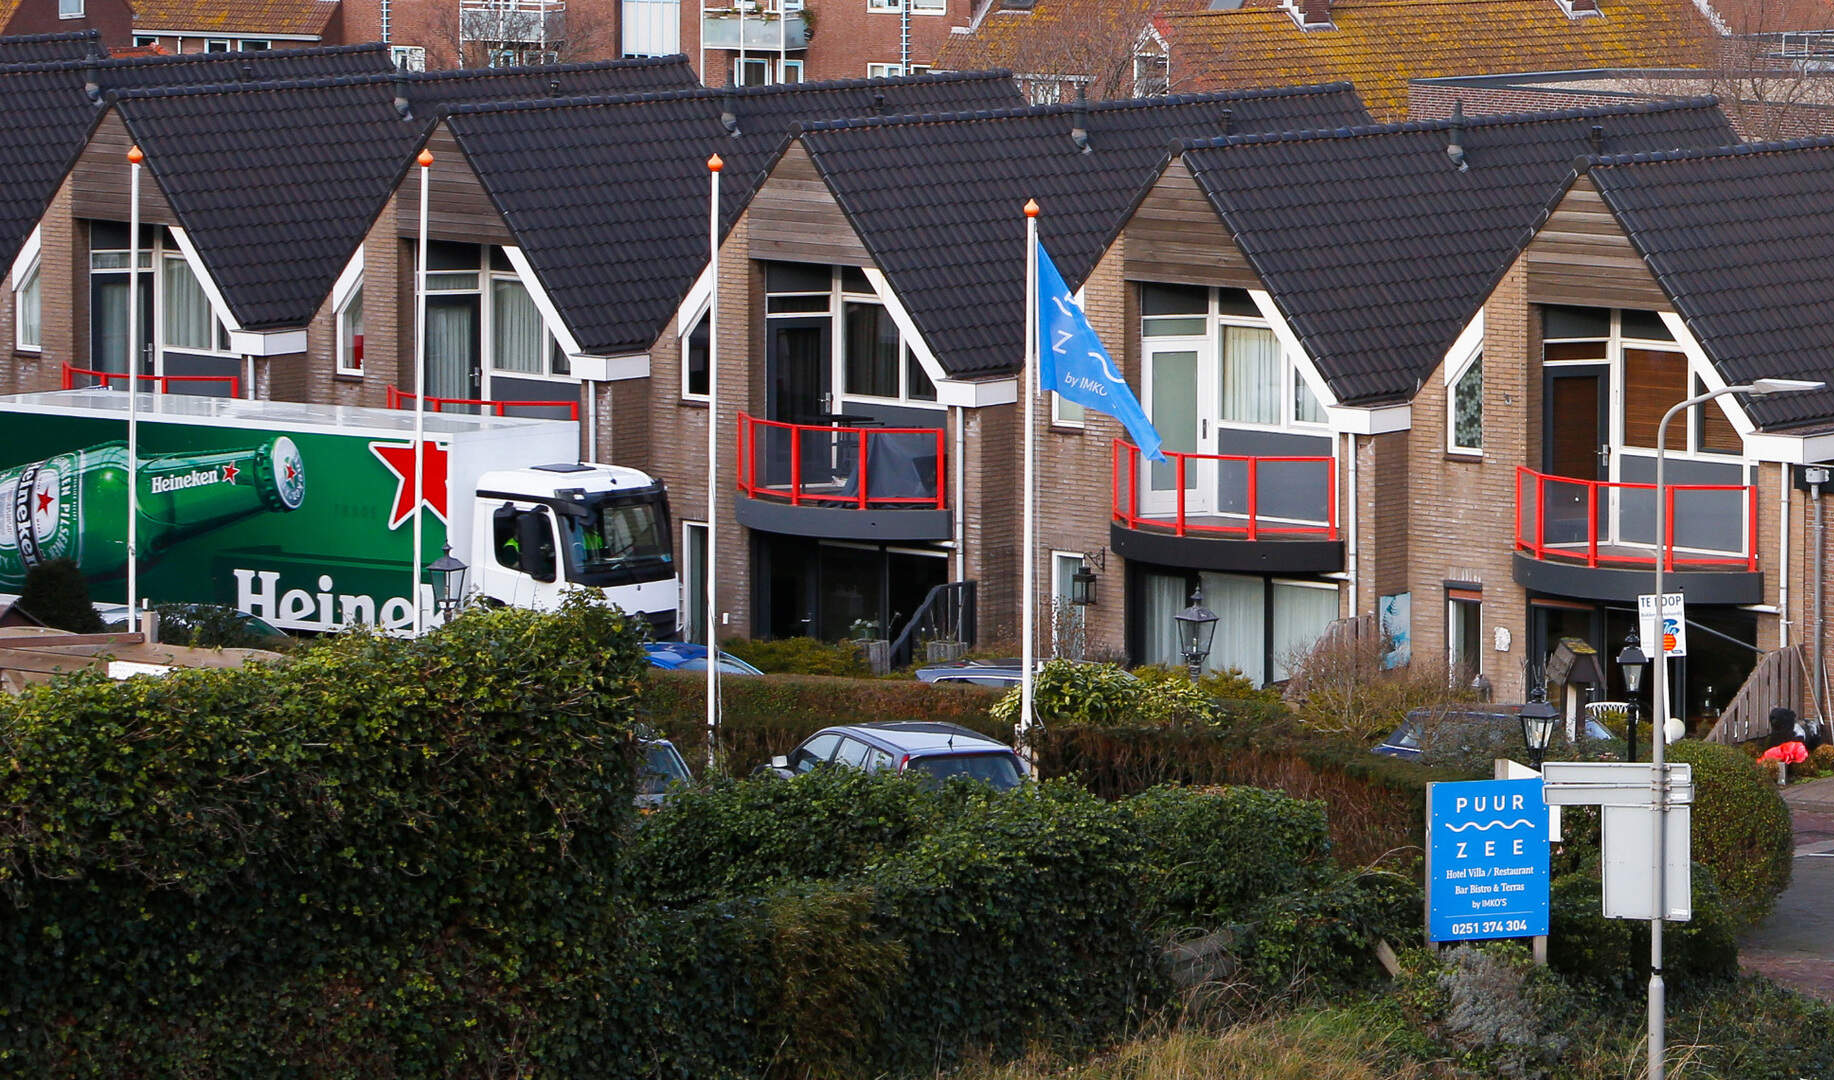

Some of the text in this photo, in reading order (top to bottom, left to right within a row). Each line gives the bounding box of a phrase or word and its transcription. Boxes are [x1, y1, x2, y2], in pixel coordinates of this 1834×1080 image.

[1065, 372, 1079, 388] by
[151, 470, 218, 494] Heineken
[1640, 595, 1682, 608] TE OOP
[1456, 794, 1525, 813] PUUR
[1456, 839, 1525, 859] ZEE
[1446, 869, 1467, 879] Hotel
[1468, 868, 1486, 878] Villa
[1493, 866, 1534, 877] Restaurant
[1455, 882, 1525, 895] Bar Bistro & Terras
[1472, 900, 1481, 909] by
[1452, 920, 1527, 935] 0251 374 304
